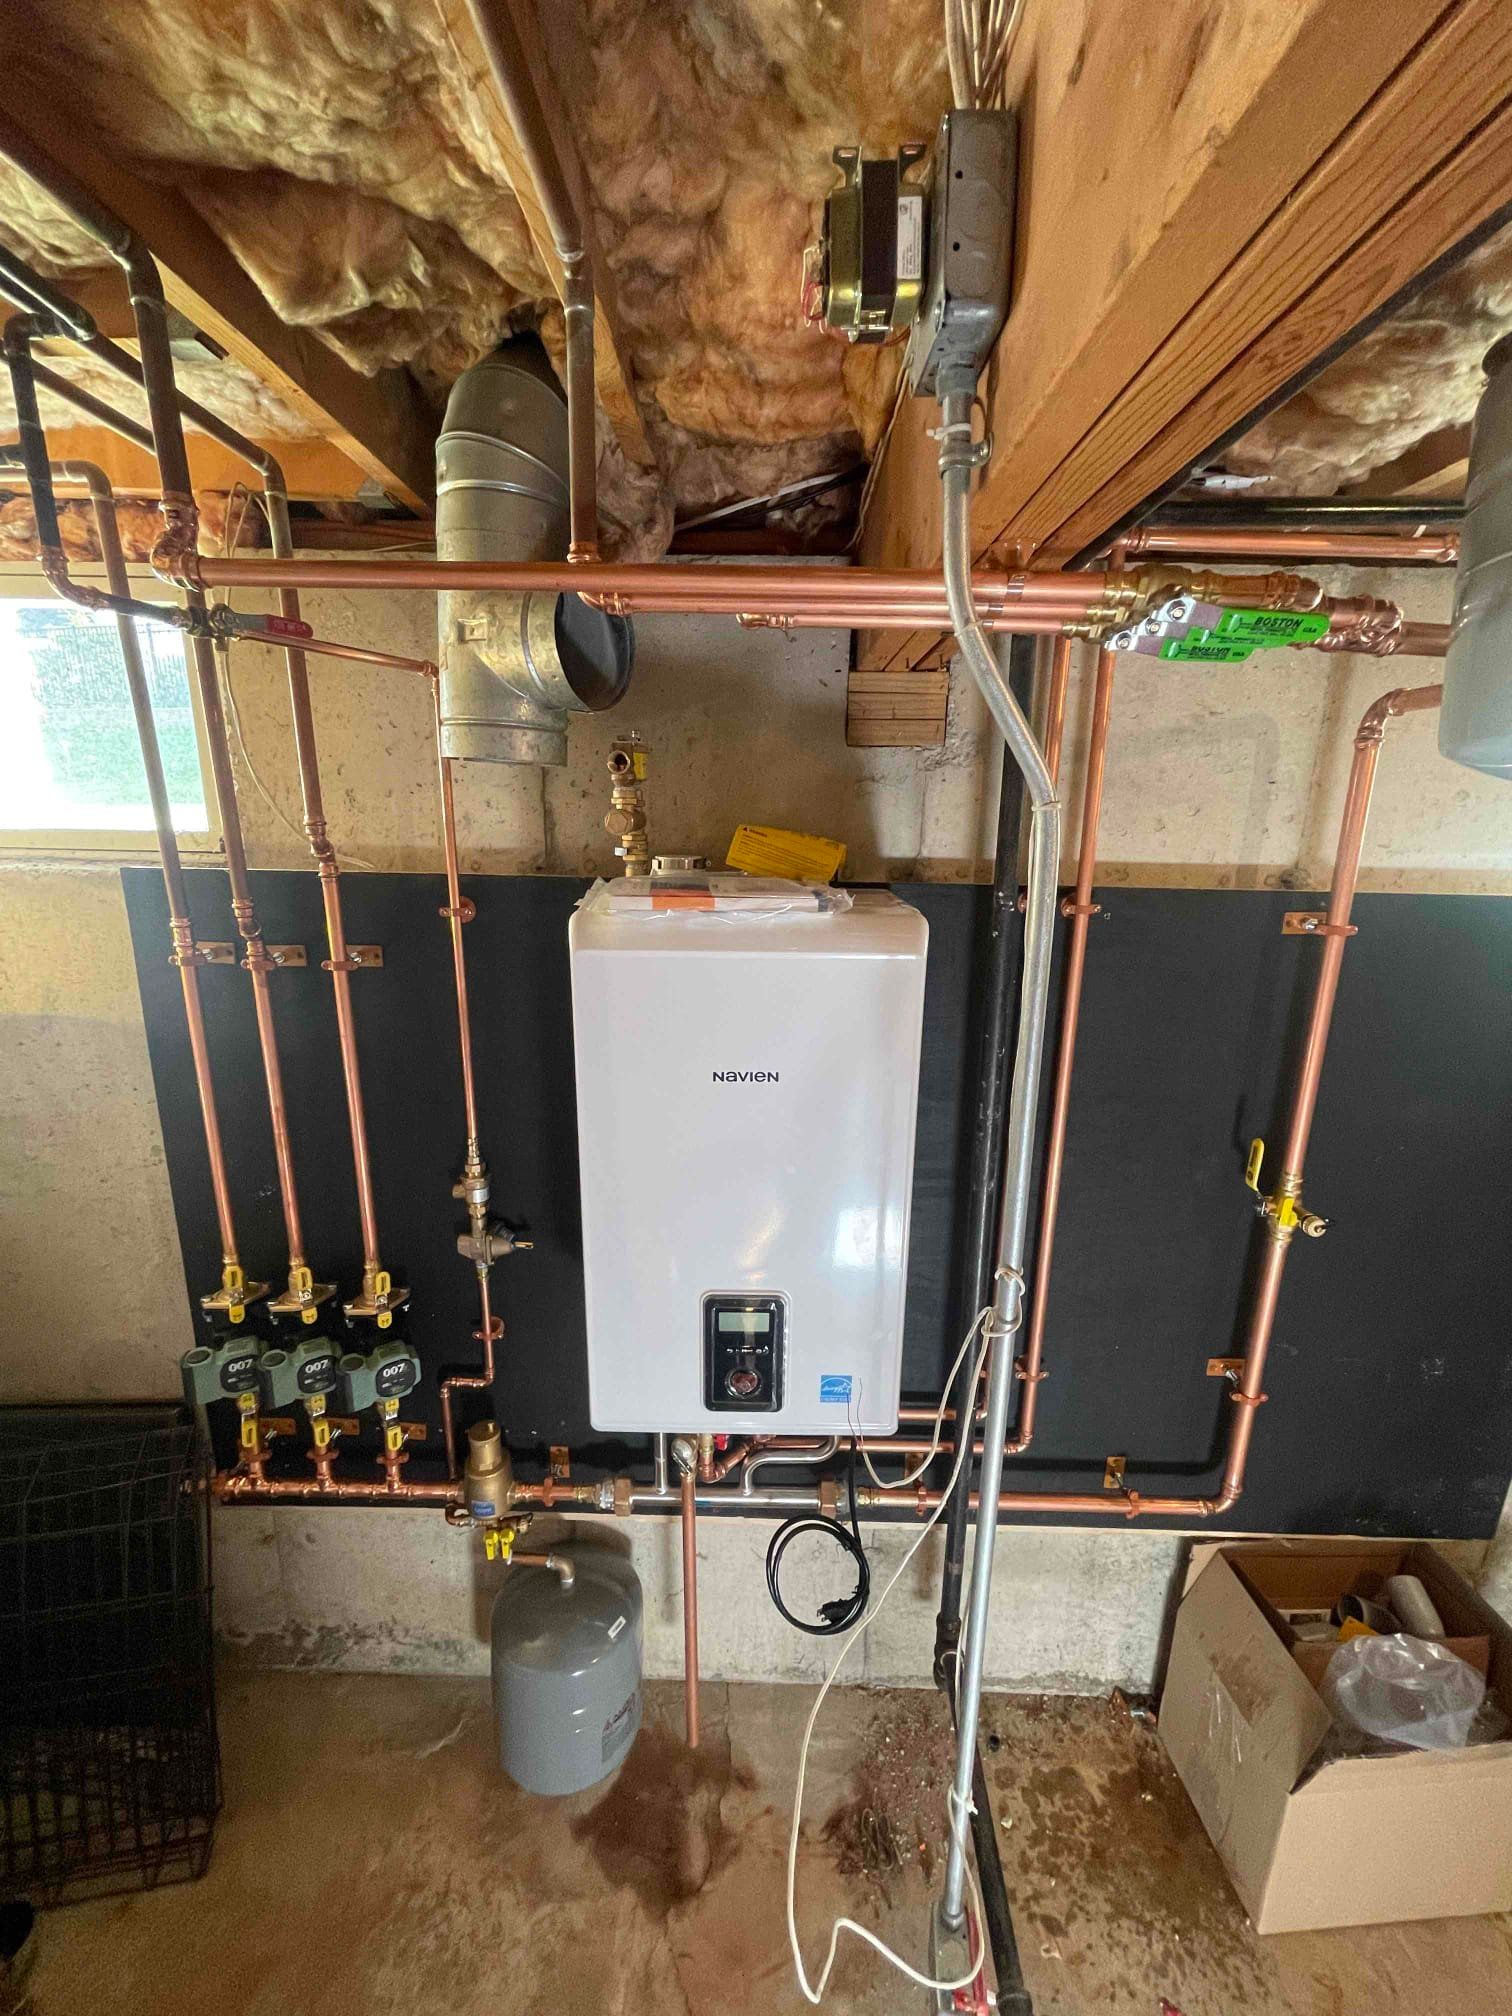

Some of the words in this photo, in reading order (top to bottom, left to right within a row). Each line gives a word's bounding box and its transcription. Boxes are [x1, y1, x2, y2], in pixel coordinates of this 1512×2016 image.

[1254, 616, 1304, 628] BOSTON
[228, 1358, 254, 1373] 007
[305, 1358, 329, 1374] 007
[382, 1362, 406, 1378] 007
